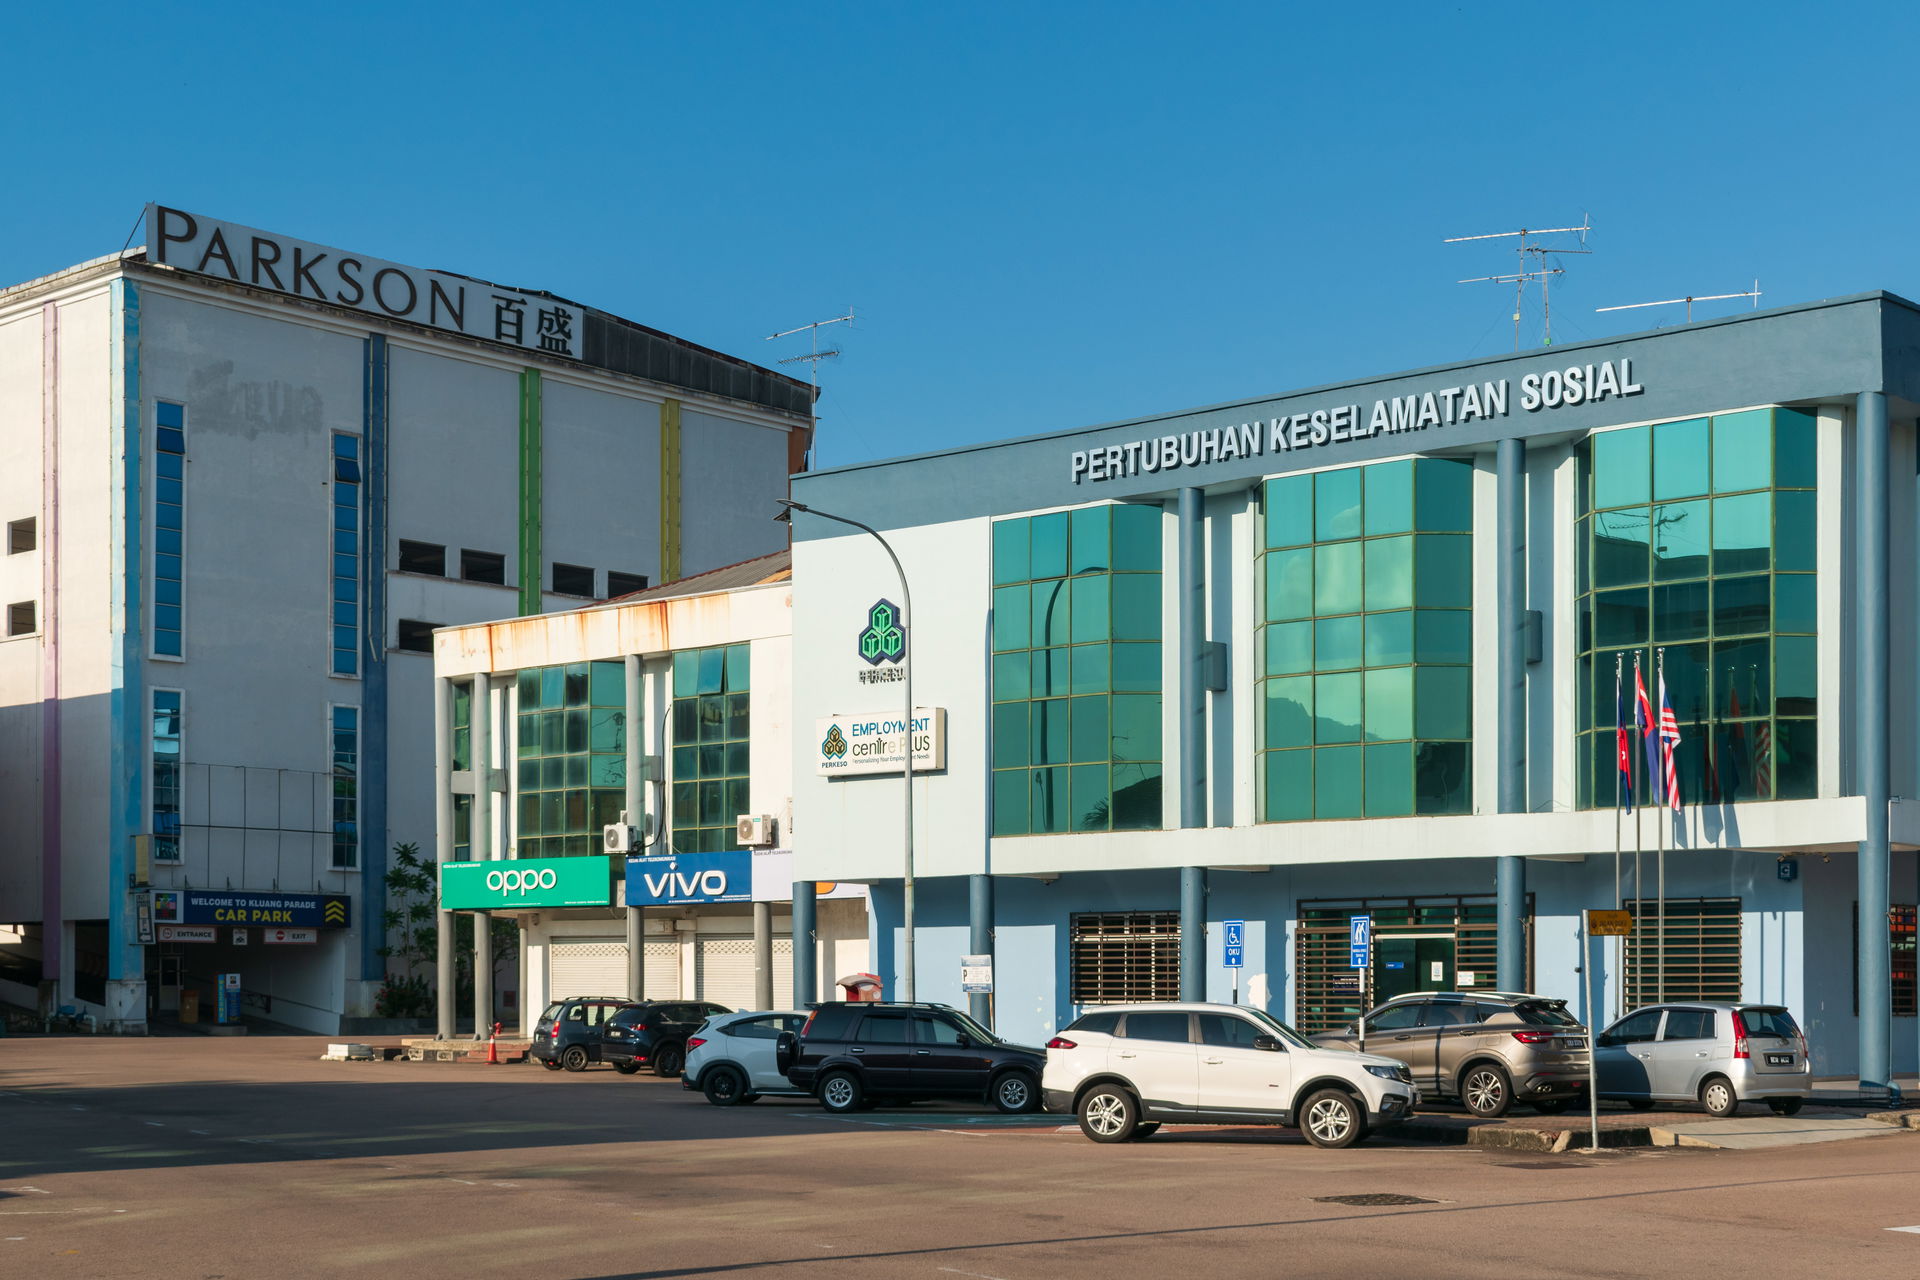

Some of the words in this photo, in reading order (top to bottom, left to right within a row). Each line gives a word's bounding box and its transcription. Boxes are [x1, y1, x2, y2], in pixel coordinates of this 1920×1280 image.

[157, 205, 465, 332] PARKSON
[491, 293, 573, 356] 百盛
[1071, 421, 1264, 483] PERTUBUHAN
[1270, 380, 1509, 451] KESELAMATAN
[1521, 358, 1645, 411] SOSIAL
[852, 718, 930, 737] EMPLOYMENT
[852, 737, 895, 757] centre
[821, 761, 848, 769] PERKESO
[486, 868, 557, 897] oppo
[643, 861, 727, 898] vivo
[191, 897, 233, 907] WELCOME
[235, 899, 246, 908] TO
[248, 899, 282, 908] KLUANG
[284, 900, 316, 910] PARADE
[215, 908, 247, 922] CAR
[252, 909, 293, 923] PARK
[177, 931, 212, 939] ENTRANCE
[292, 932, 306, 940] EXIT
[1228, 948, 1240, 956] OKU
